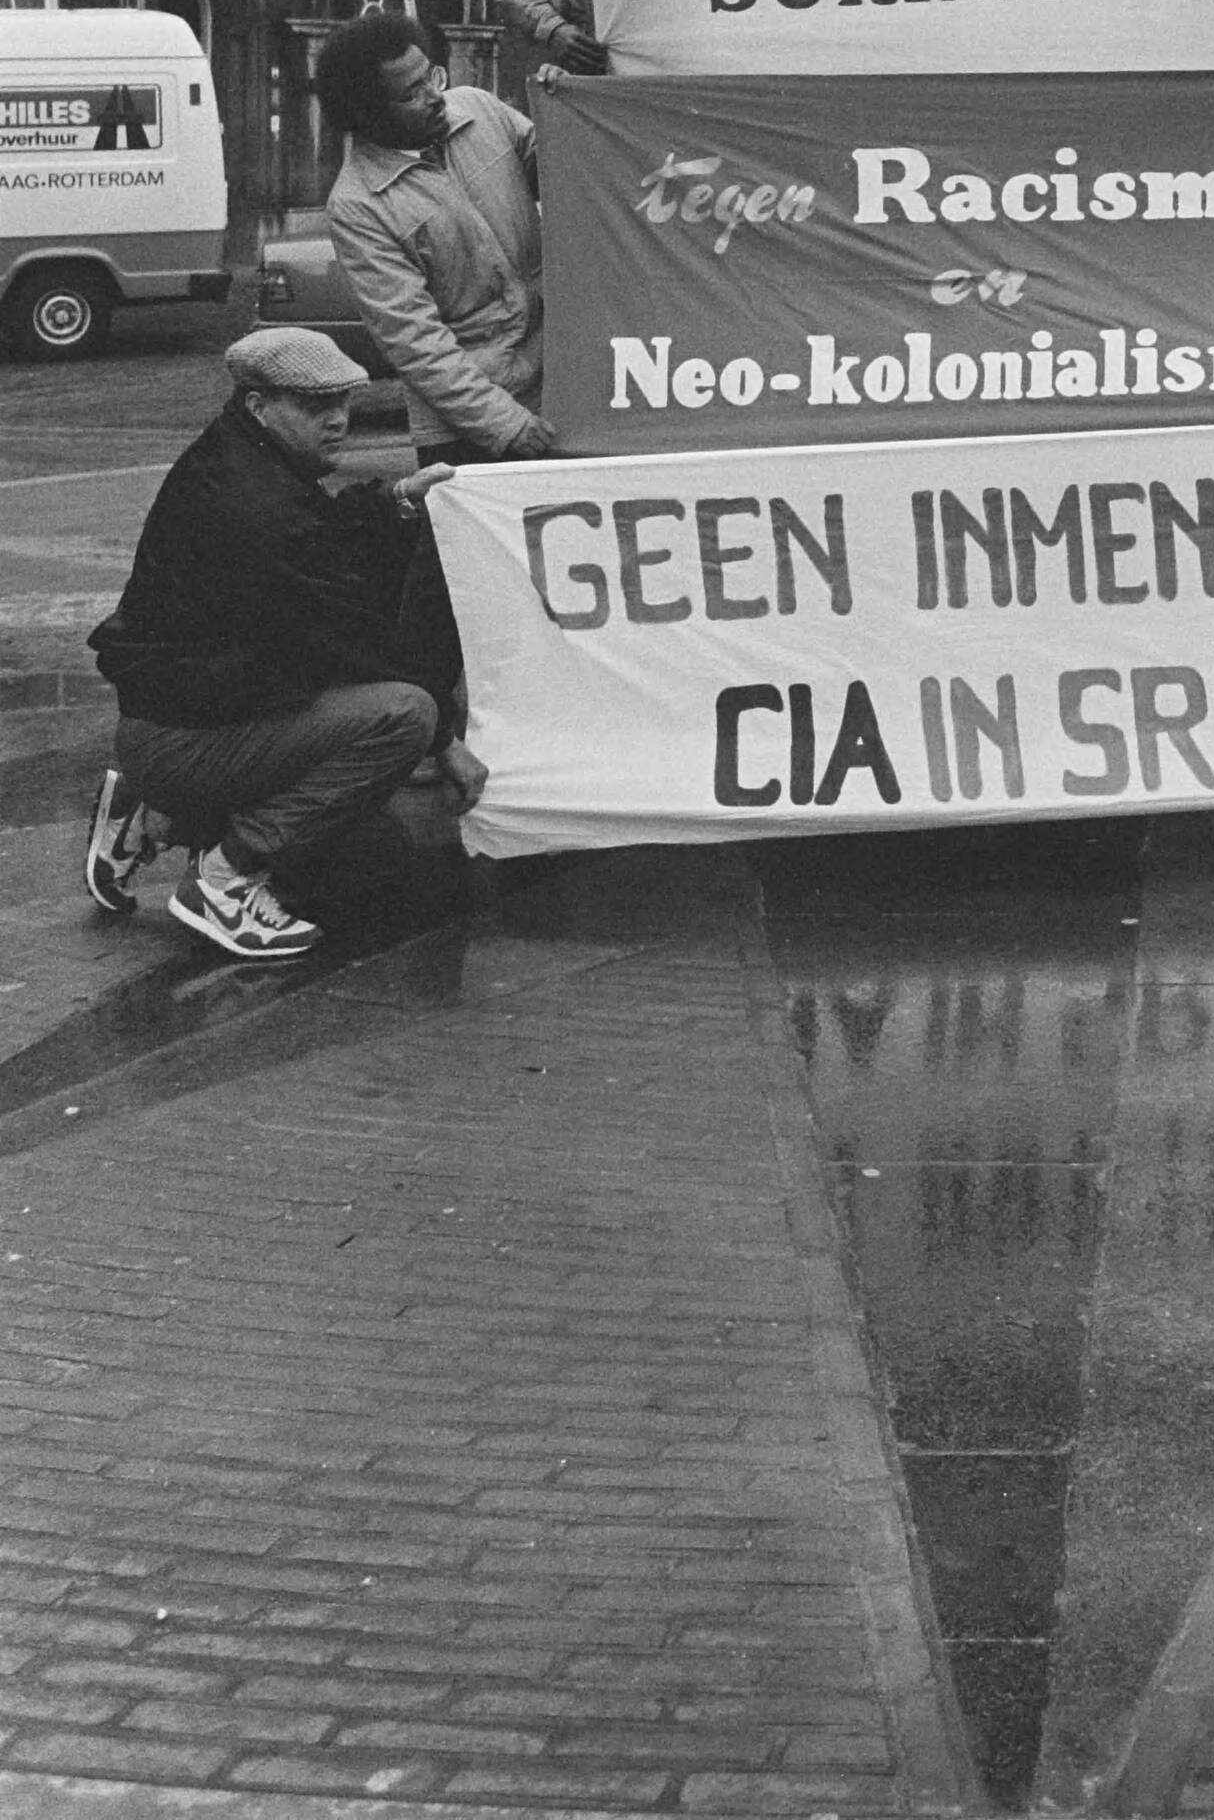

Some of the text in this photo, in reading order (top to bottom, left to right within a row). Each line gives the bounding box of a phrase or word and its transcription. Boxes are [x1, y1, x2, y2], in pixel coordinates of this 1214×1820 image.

[930, 265, 1029, 307] en
[522, 493, 853, 630] GEEN
[714, 680, 902, 807] CIA
[919, 673, 1026, 802] IN
